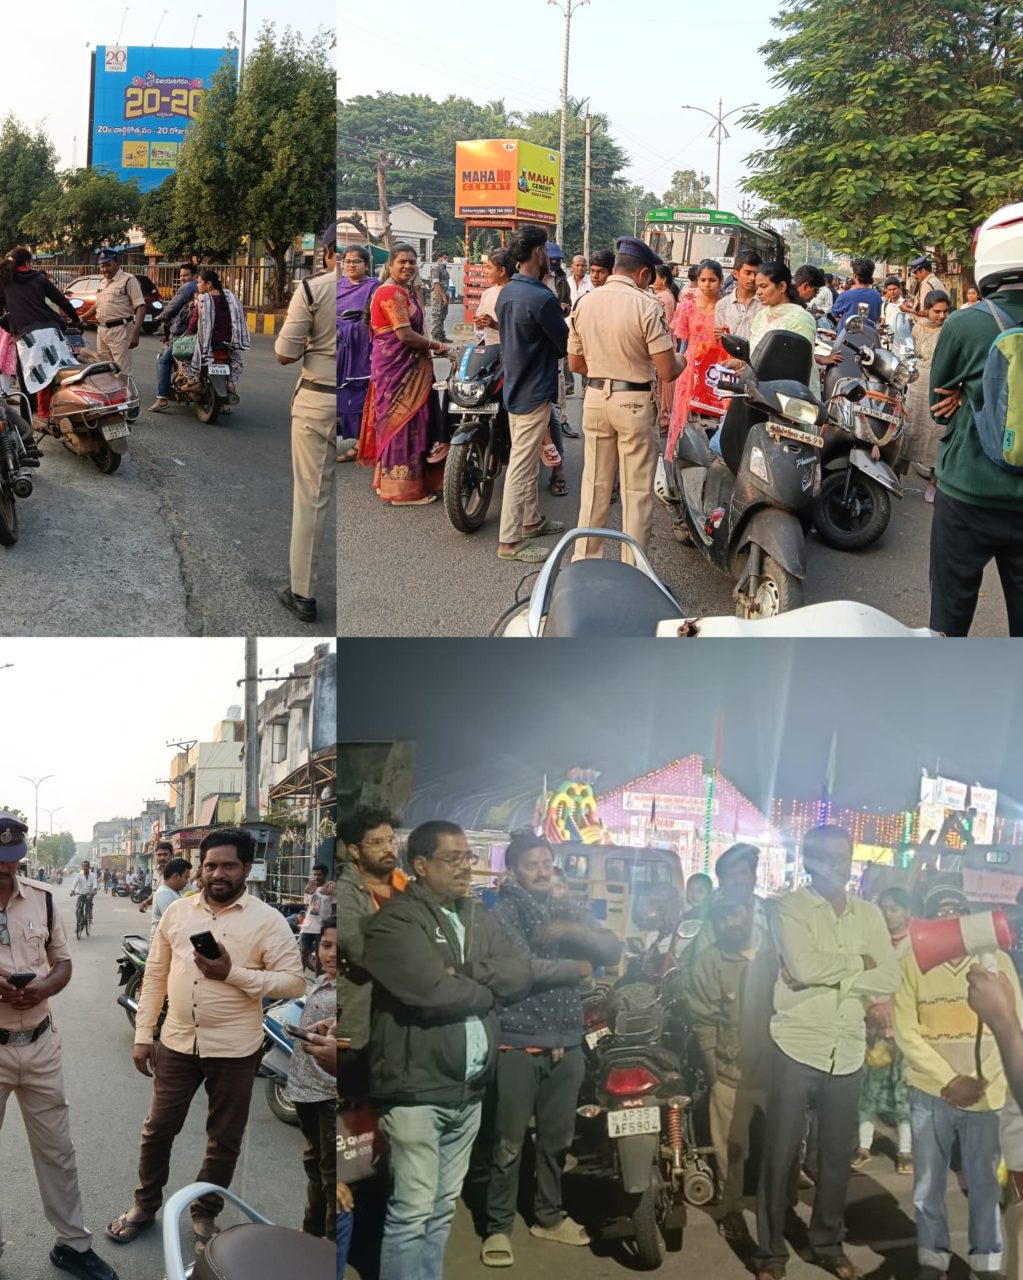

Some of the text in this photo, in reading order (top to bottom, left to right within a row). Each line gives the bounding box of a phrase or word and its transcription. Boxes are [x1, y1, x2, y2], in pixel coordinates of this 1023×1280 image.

[106, 51, 126, 65] 20
[462, 171, 496, 183] MAHA
[528, 172, 555, 187] MAHA
[532, 183, 552, 193] CEMENT
